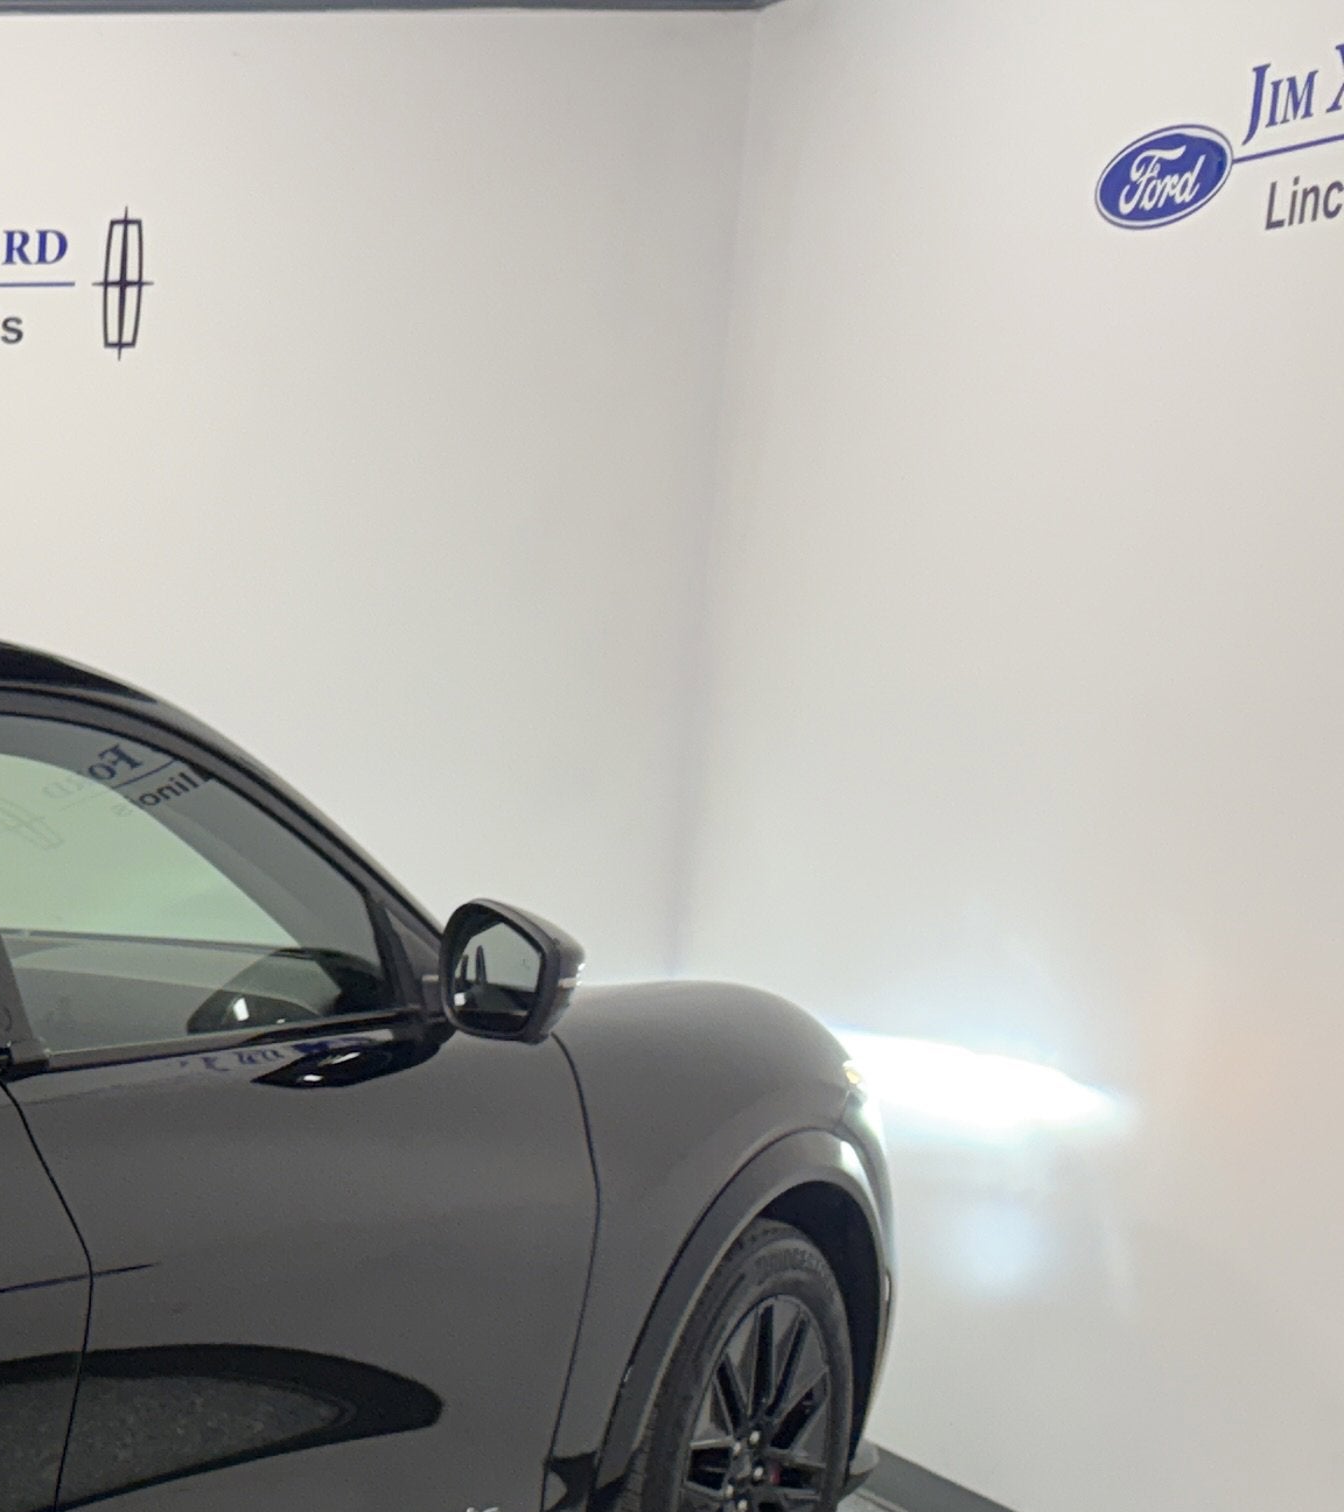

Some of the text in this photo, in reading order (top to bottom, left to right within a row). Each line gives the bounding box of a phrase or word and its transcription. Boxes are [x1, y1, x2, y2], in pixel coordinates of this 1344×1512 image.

[1242, 63, 1319, 146] JIM
[1119, 144, 1207, 216] Ford
[1265, 175, 1344, 230] Linc
